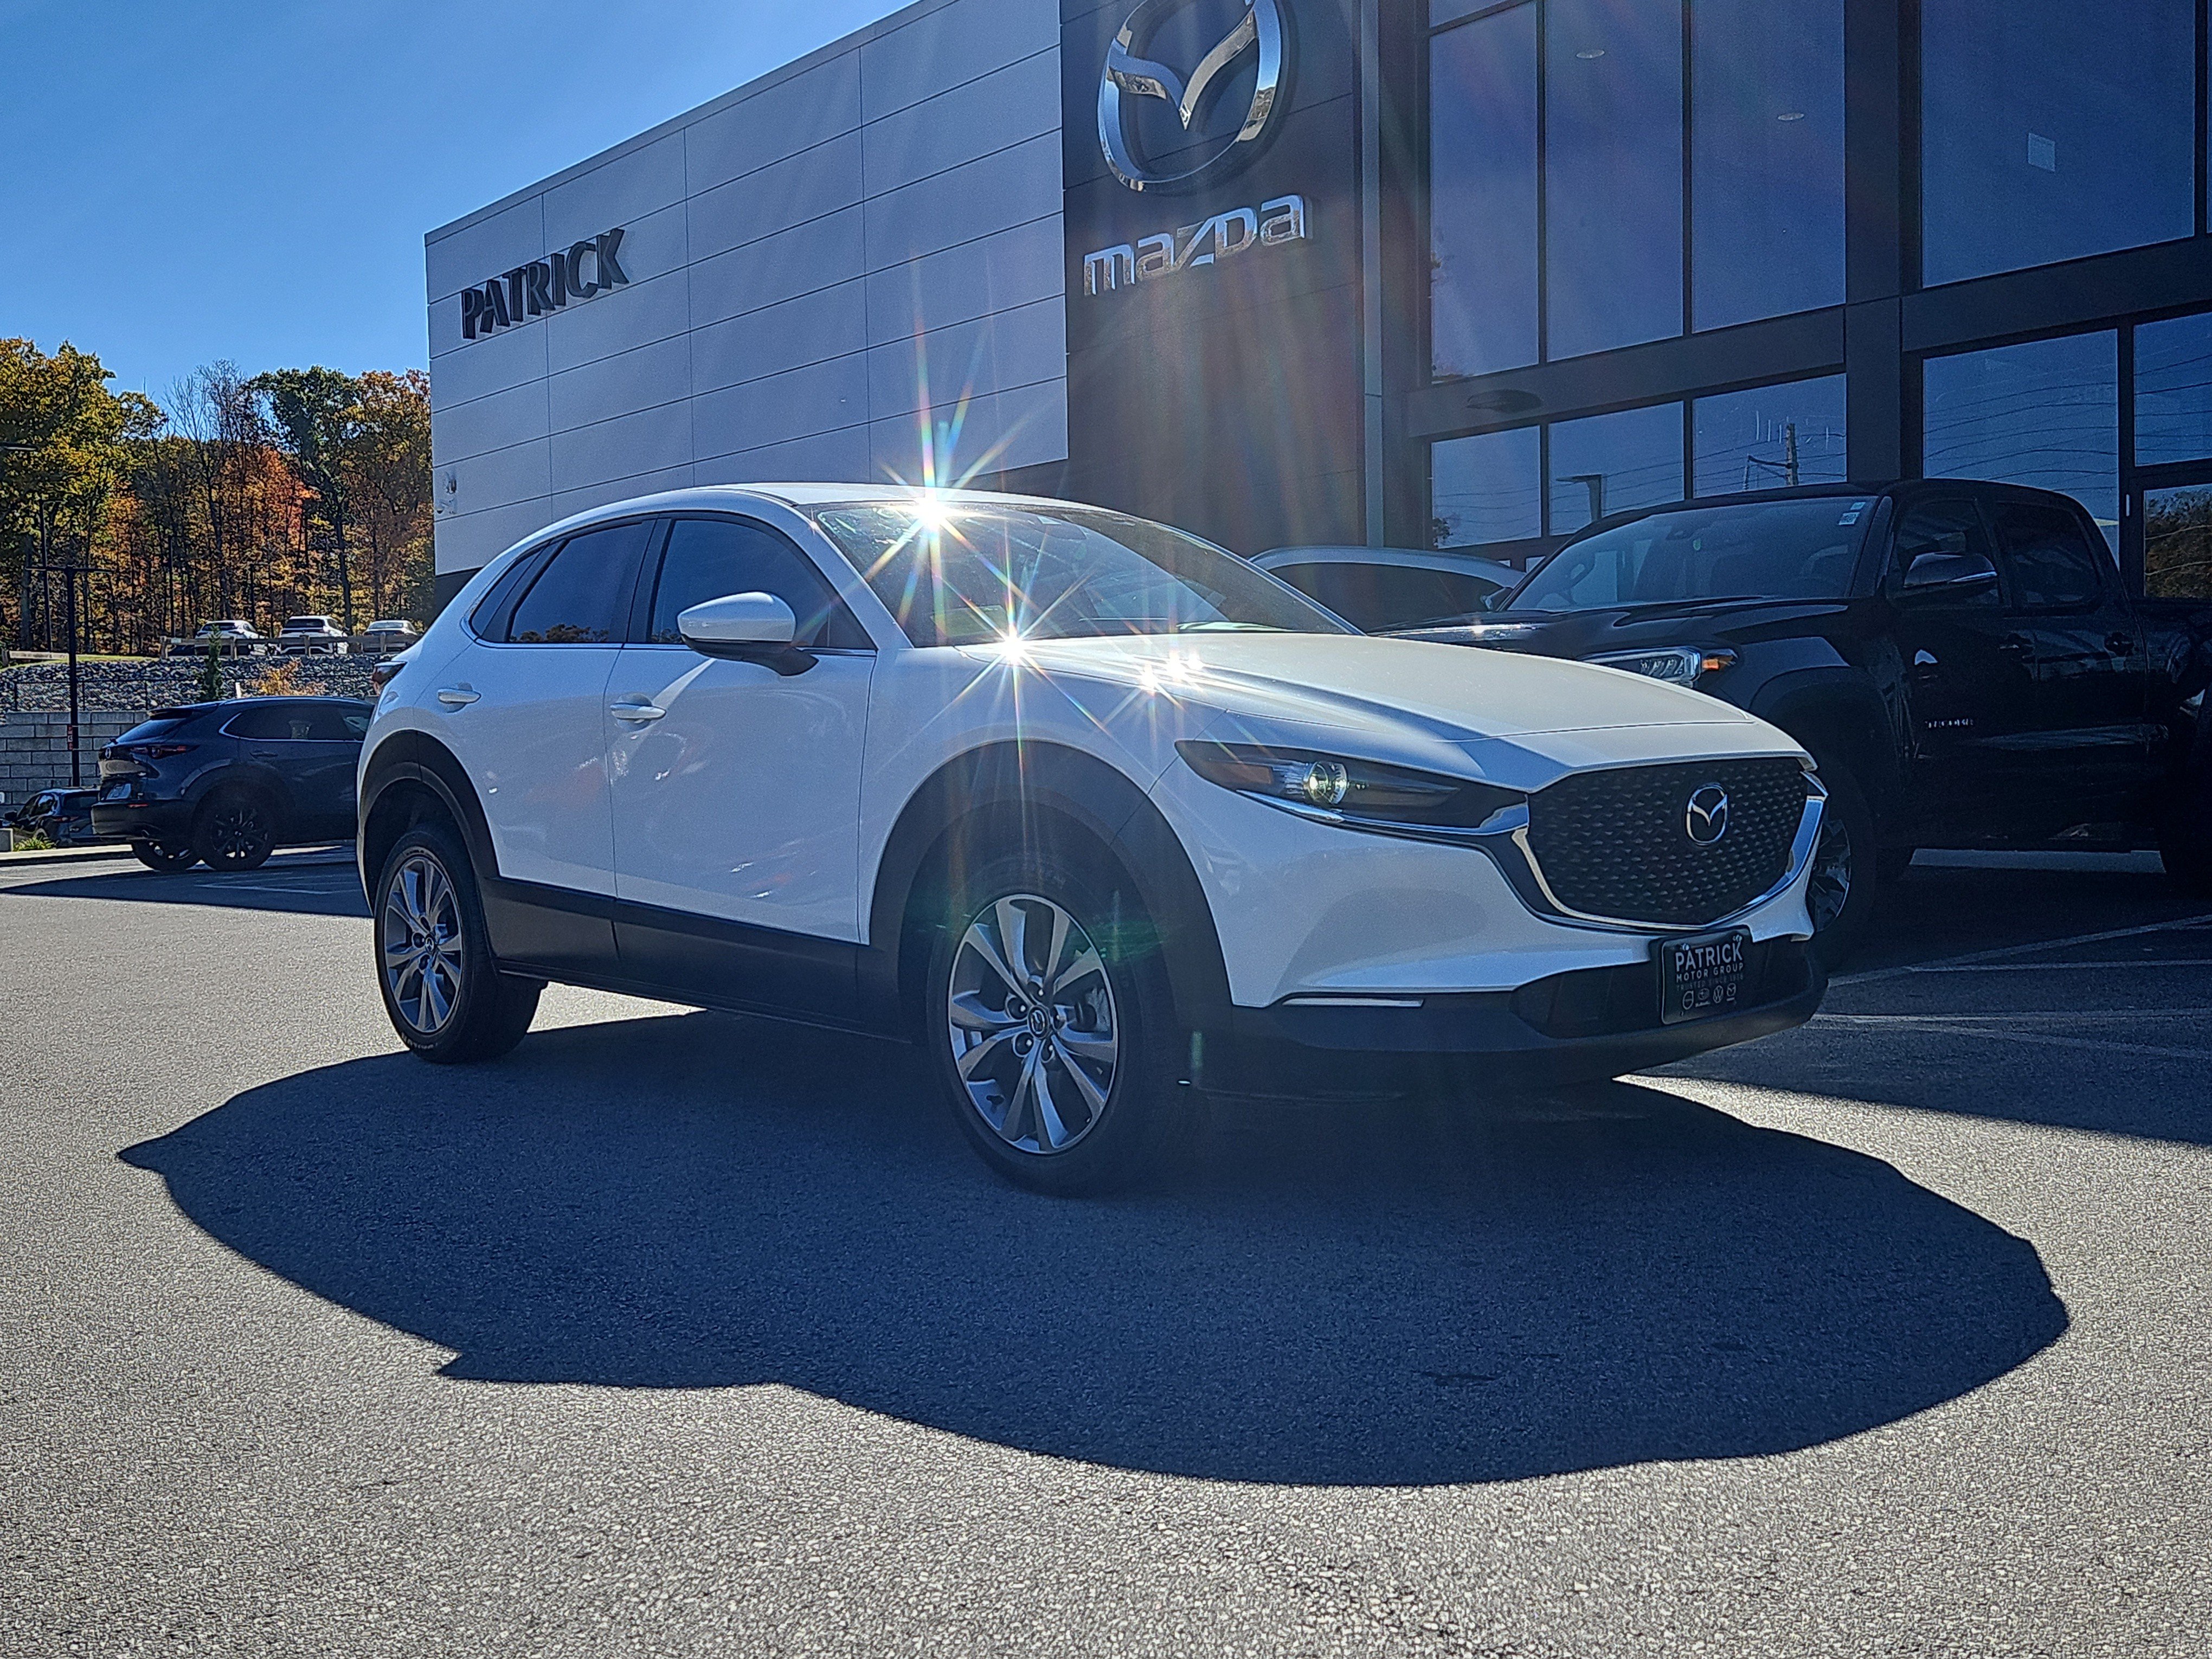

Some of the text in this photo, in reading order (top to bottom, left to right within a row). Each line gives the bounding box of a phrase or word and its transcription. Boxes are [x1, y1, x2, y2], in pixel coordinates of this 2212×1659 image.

[461, 228, 629, 339] PATRICK
[1675, 942, 1743, 972] PATRICK
[1676, 962, 1744, 983] MOTOR GROUP
